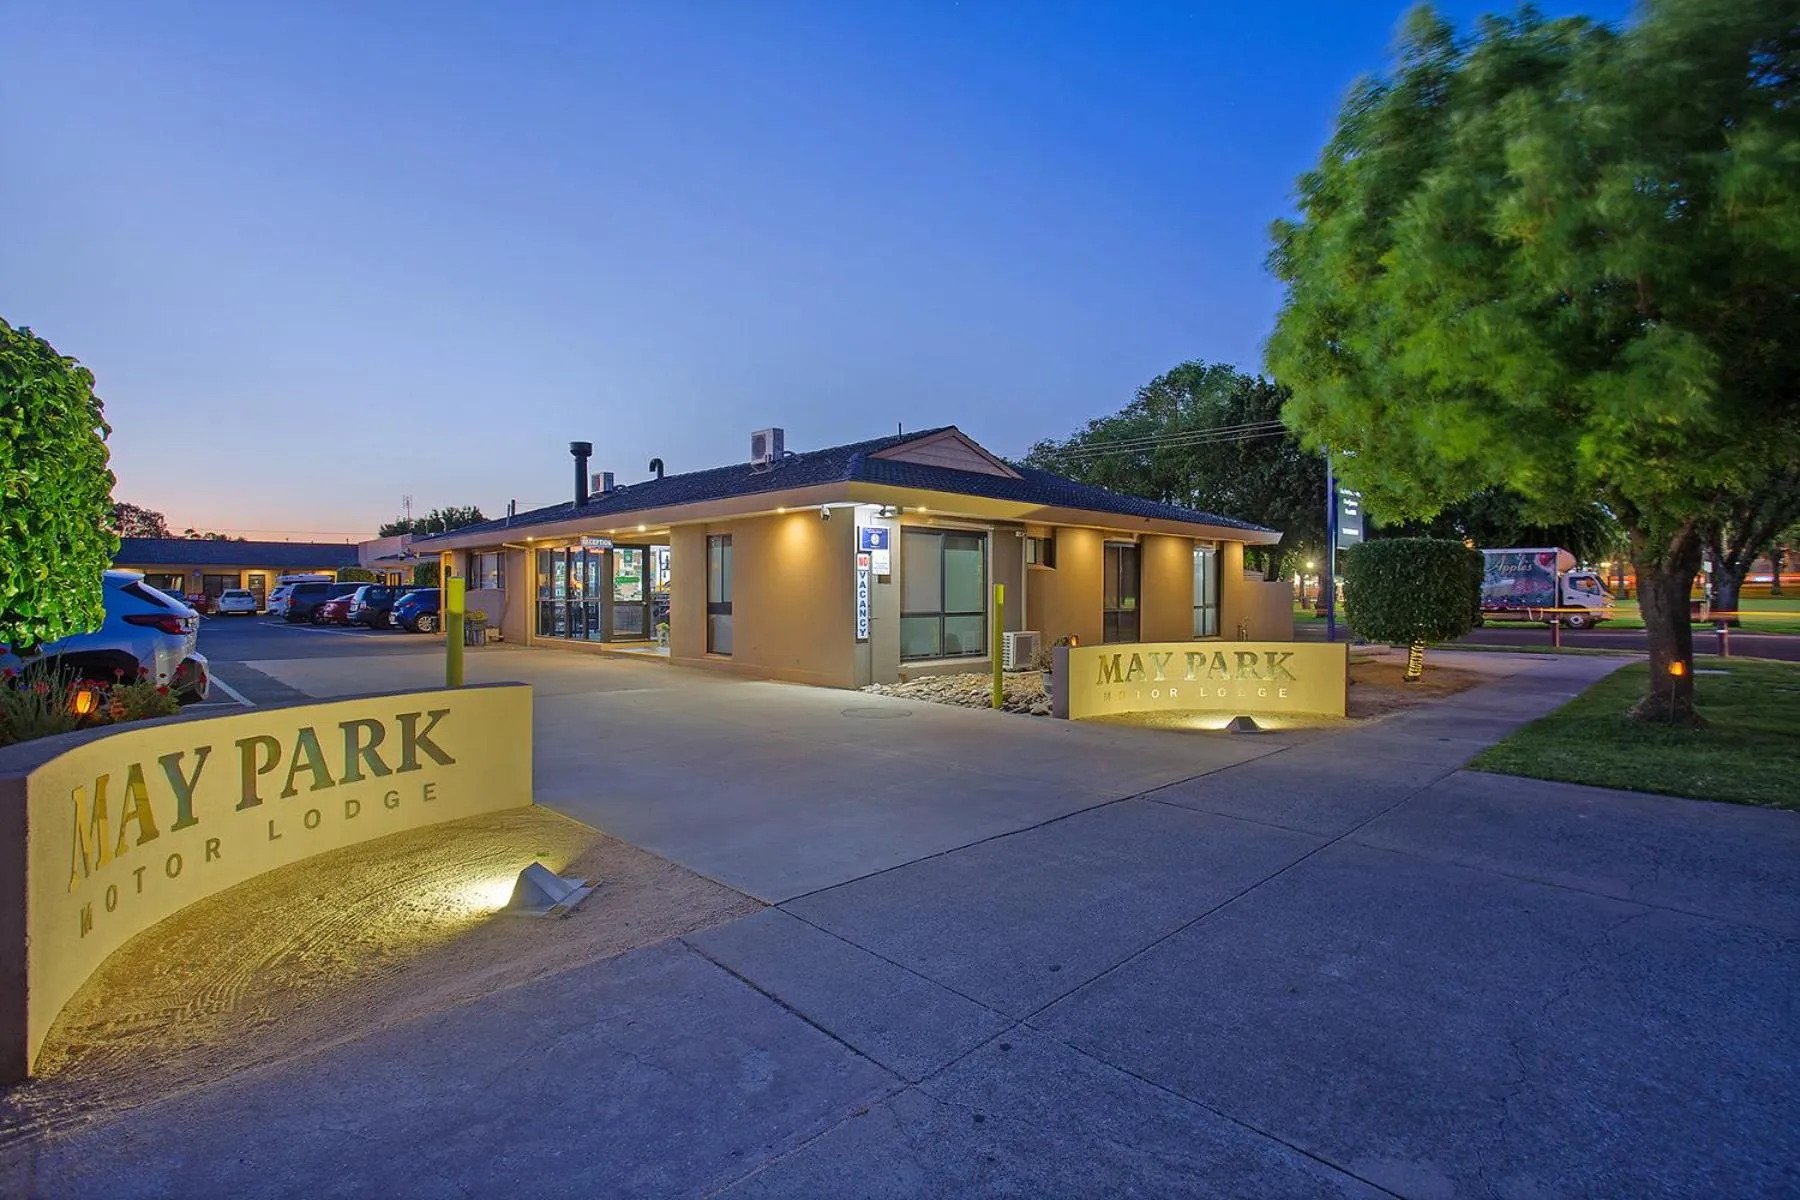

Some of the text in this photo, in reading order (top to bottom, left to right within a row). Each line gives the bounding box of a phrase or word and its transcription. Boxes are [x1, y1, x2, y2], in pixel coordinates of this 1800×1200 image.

[858, 556, 868, 567] NO
[1485, 555, 1533, 575] Apples
[859, 571, 867, 637] VACANCY
[1096, 651, 1296, 686] MAY PARK
[69, 708, 456, 893] MAY PARK
[80, 782, 438, 938] MOTOR LODGE
